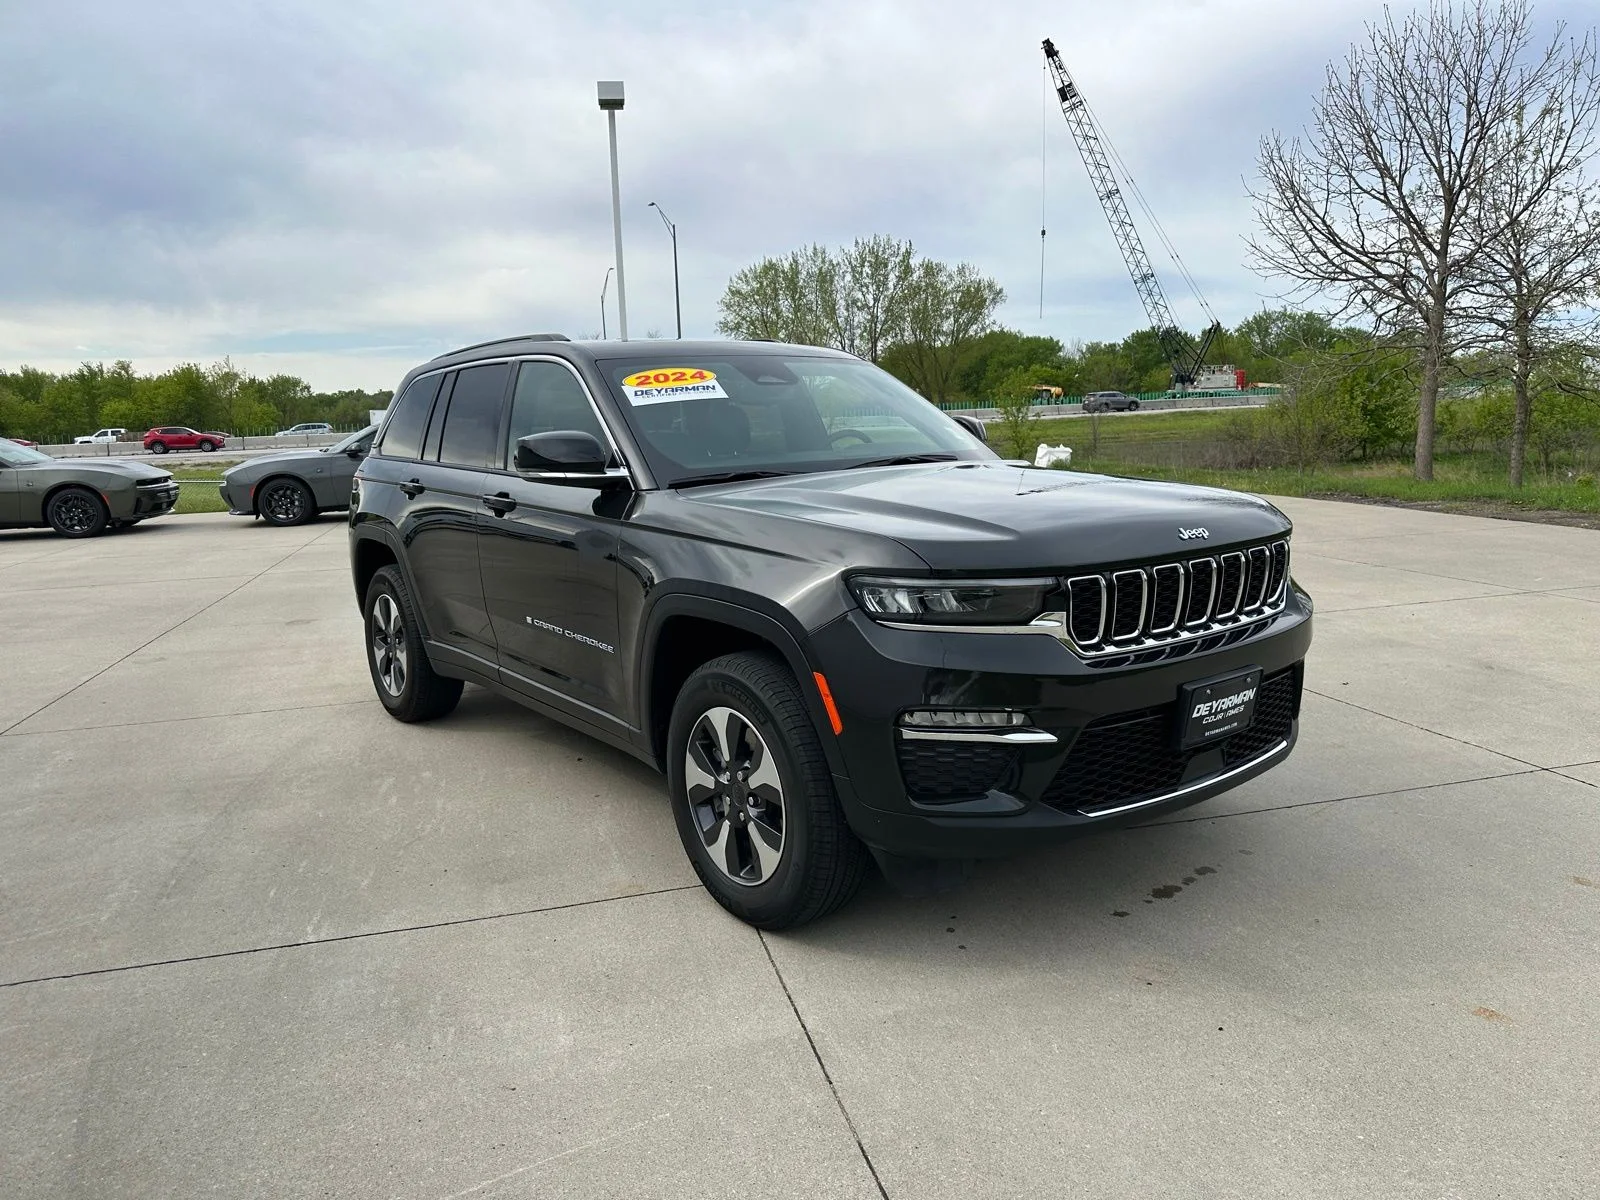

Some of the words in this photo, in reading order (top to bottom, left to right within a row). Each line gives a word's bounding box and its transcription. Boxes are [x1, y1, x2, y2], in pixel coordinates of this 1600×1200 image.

[634, 371, 708, 386] 2024
[634, 385, 716, 397] DEYARMAN
[1178, 527, 1209, 540] Jeep
[533, 619, 563, 634] GRAND
[564, 630, 615, 654] CHEROKEE
[1191, 687, 1257, 719] DEYARMAN
